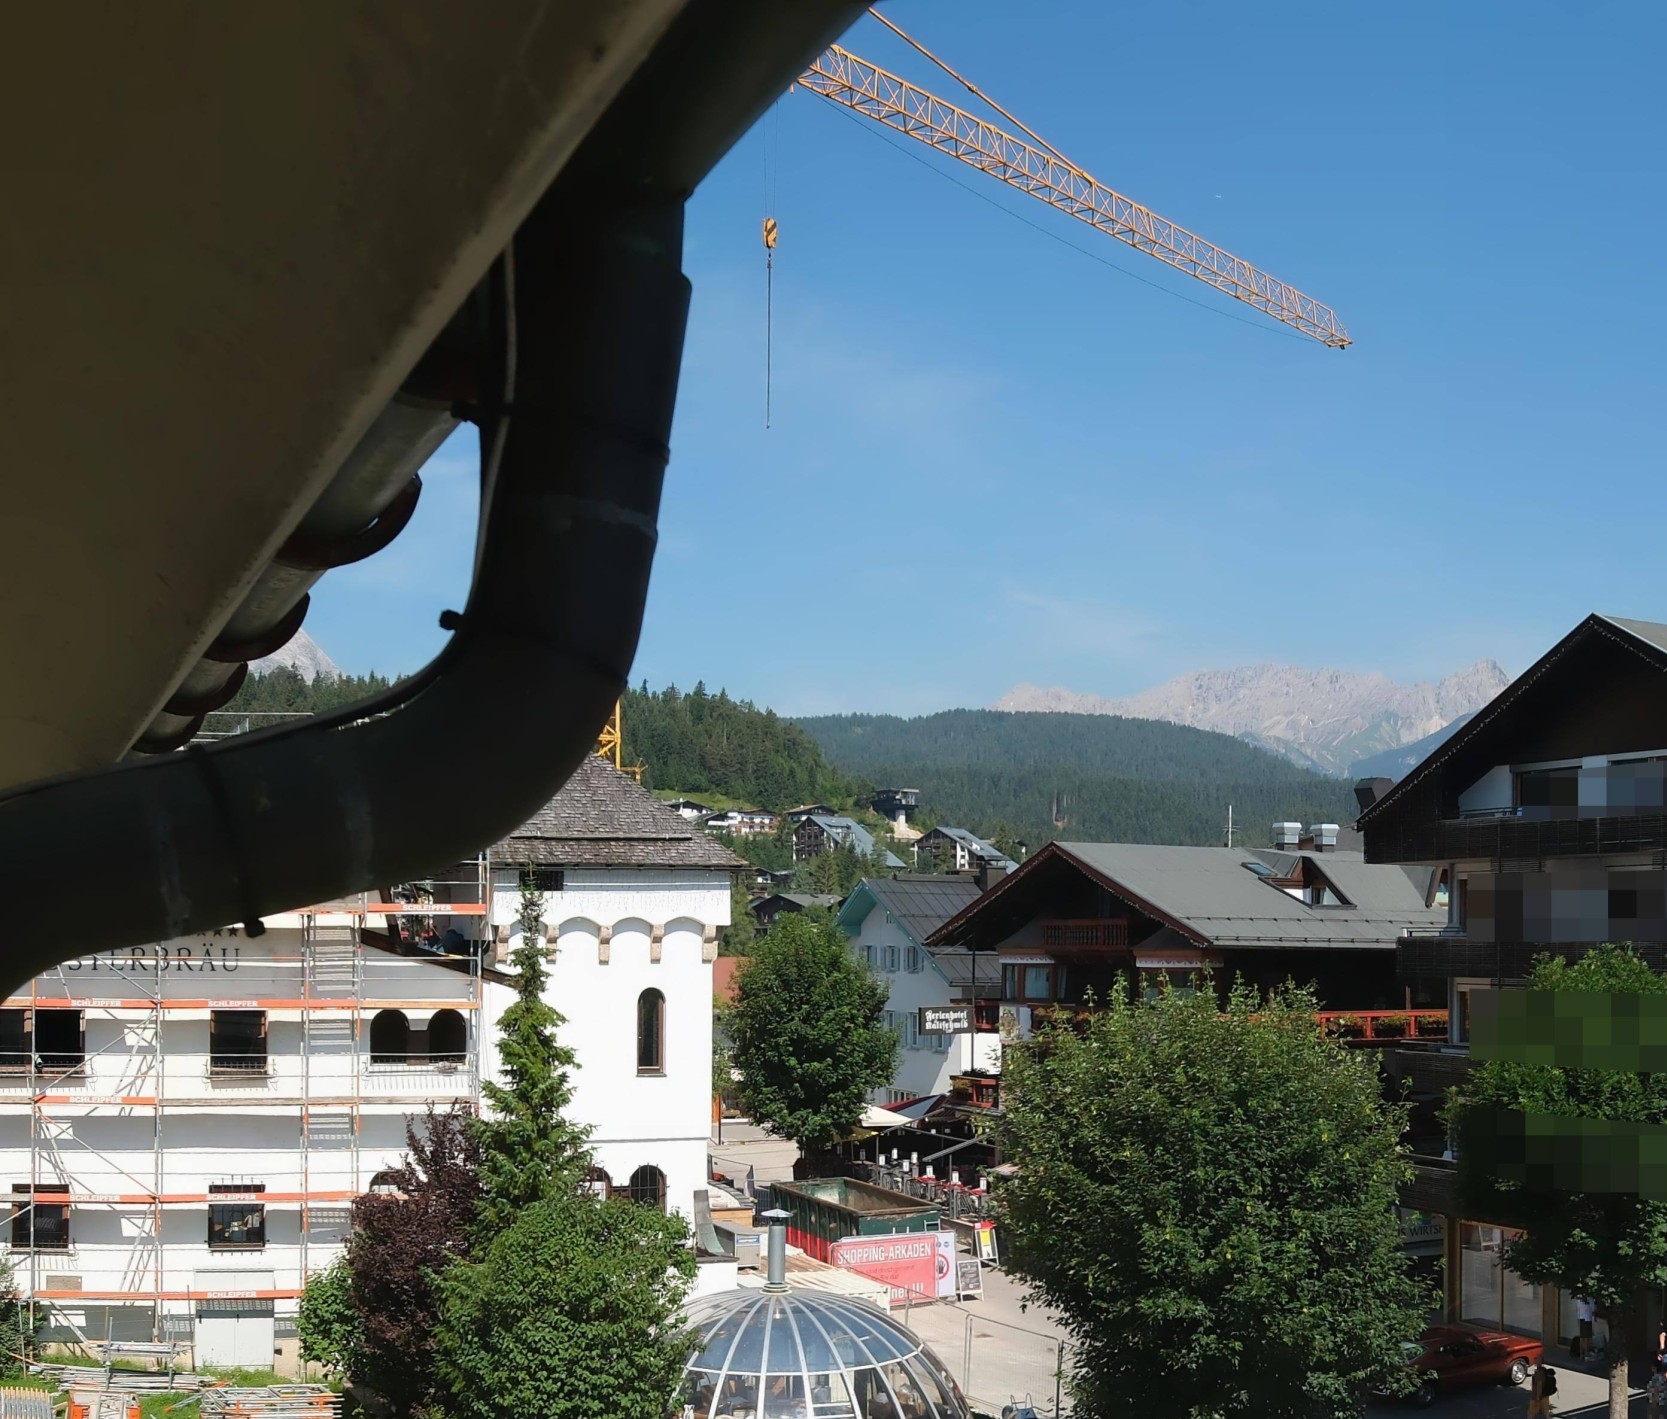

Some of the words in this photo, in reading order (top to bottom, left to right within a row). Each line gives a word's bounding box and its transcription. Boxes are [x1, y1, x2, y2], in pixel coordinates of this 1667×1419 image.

[402, 903, 452, 911] SCHLEIPFER
[69, 1096, 123, 1104] SCHLEIPFER
[837, 1242, 932, 1265] SHOPPING-ARKADEN
[207, 1291, 257, 1299] SCHLEIPFER
